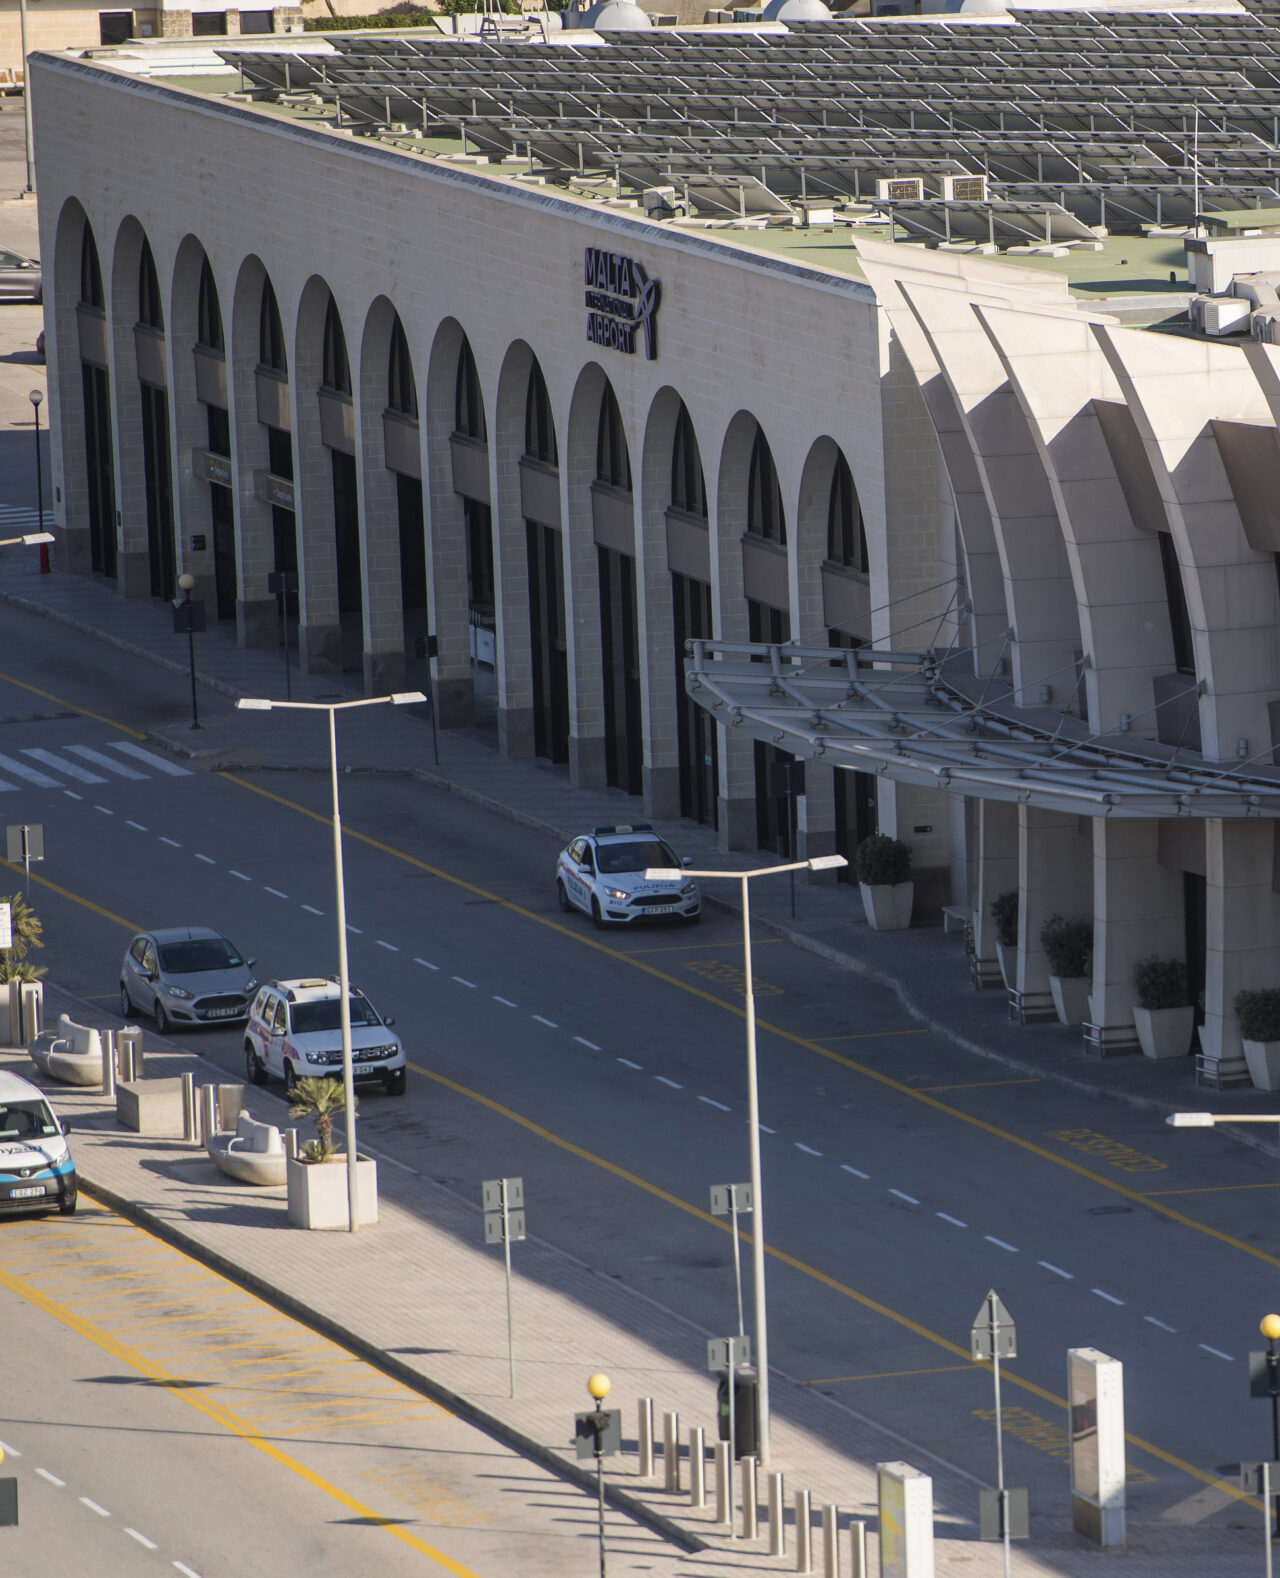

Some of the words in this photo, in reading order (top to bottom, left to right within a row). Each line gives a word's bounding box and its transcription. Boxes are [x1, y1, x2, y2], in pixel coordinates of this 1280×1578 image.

[585, 247, 636, 298] MALTA
[587, 312, 636, 354] AIRPORT
[1043, 1128, 1169, 1172] RESERVED
